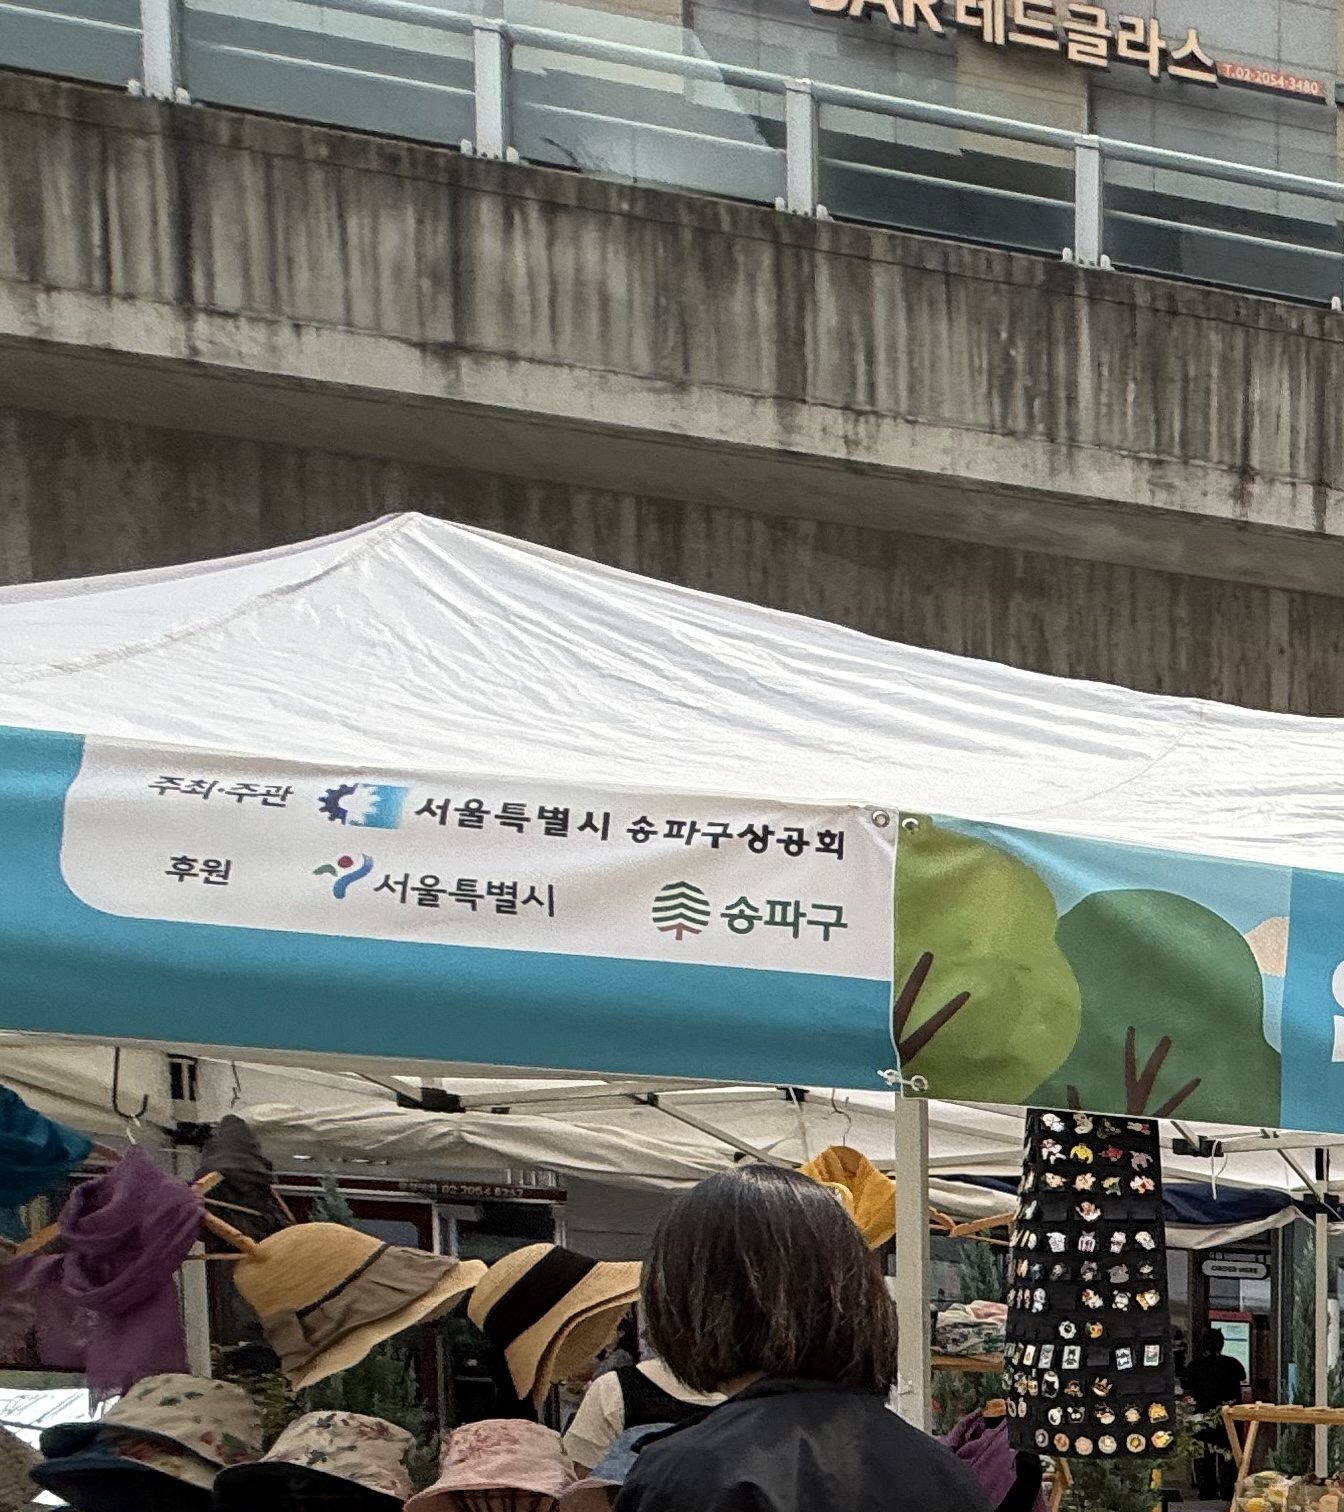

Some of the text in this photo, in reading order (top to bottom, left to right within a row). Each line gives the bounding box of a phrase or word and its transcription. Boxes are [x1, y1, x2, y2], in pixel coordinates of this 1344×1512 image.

[956, 0, 1217, 83] 레드글라스
[147, 775, 845, 860] 주최·주관 서울특별시 송파구상공회
[165, 855, 848, 941] 후원 서울특별시 송파구
